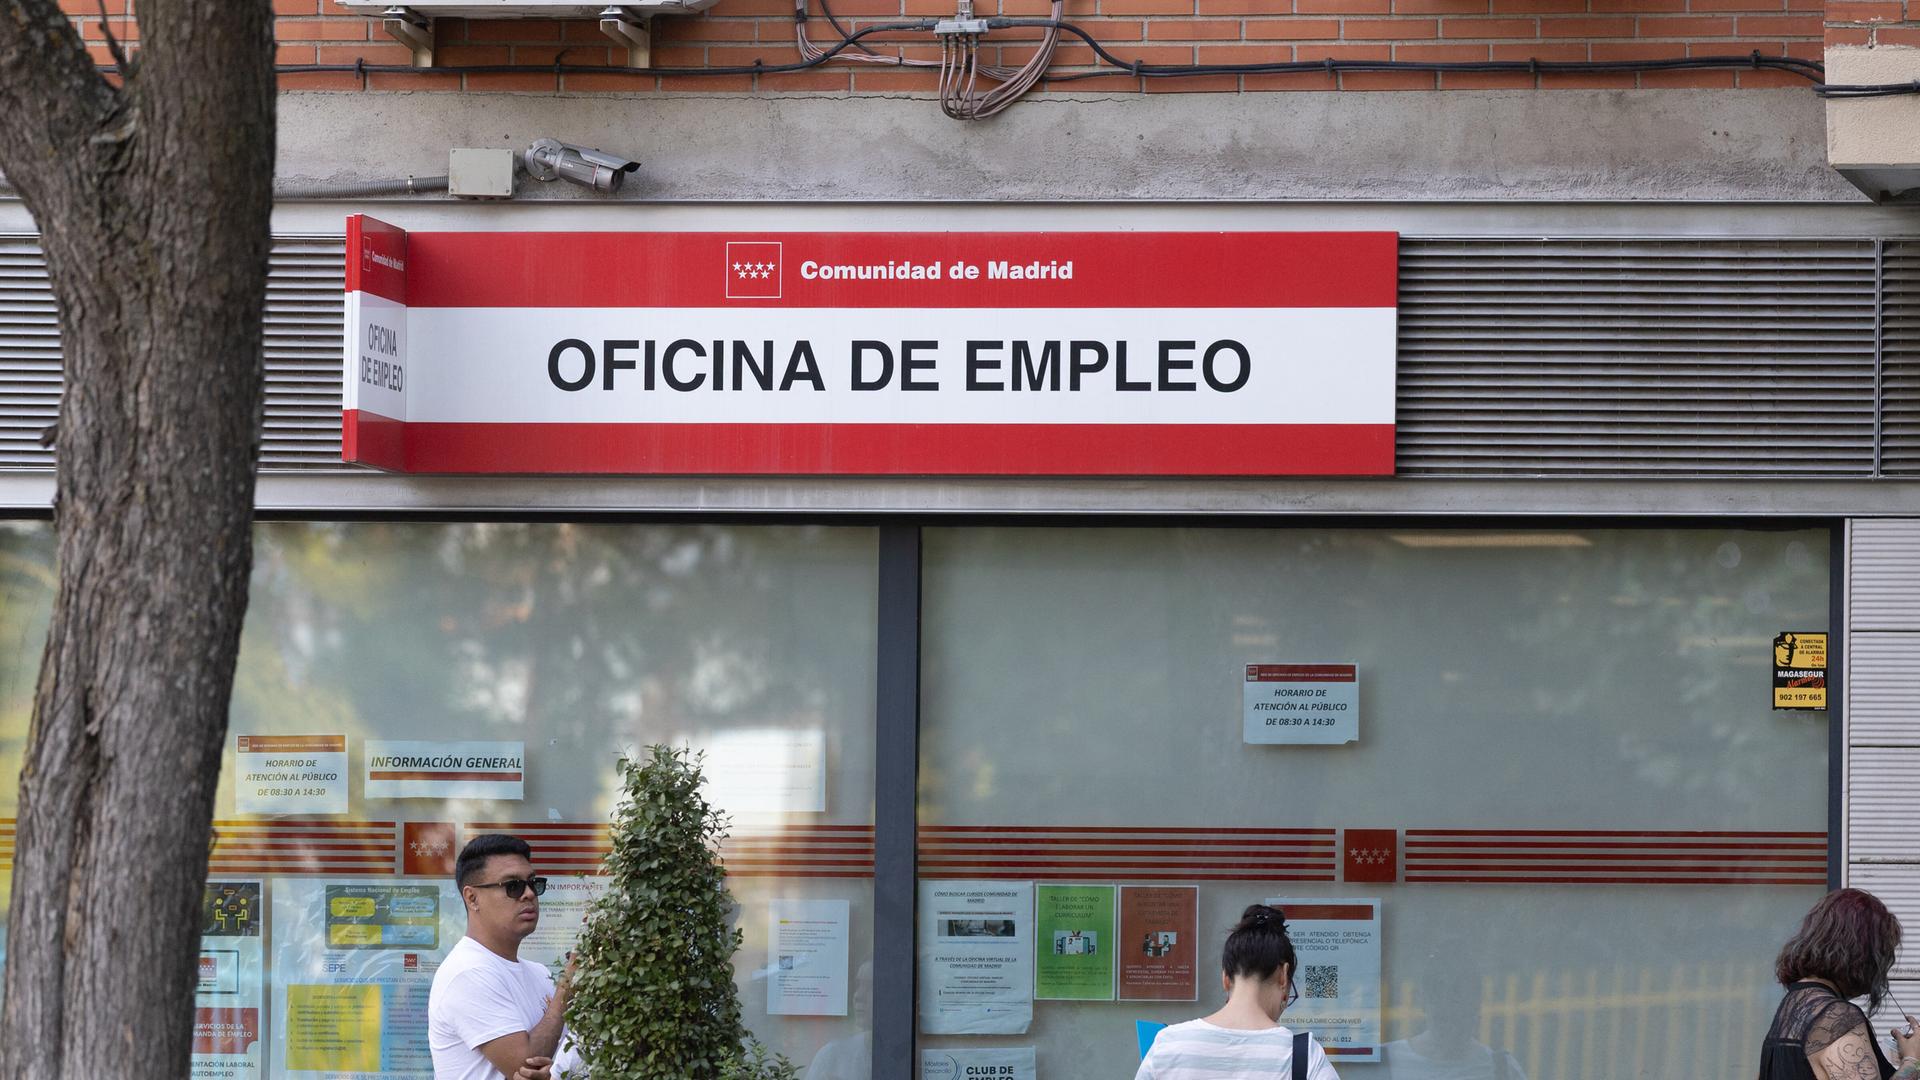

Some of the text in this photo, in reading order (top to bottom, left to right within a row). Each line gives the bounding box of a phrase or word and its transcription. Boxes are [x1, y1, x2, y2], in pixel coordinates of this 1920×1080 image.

[372, 250, 404, 272] Comunidad de Madrid
[800, 260, 1074, 280] Comunidad de Madrid
[368, 323, 397, 357] OFICINA
[547, 338, 1252, 393] OFICINA DE EMPLEO
[361, 355, 403, 393] DE EMPLEO
[1777, 670, 1824, 678] MAGASEGUR
[1274, 689, 1327, 697] HORARIO DE
[1254, 702, 1298, 711] ATENCIÓN
[1311, 702, 1347, 711] PÚBLICO
[1265, 718, 1335, 726] DE 08:30 A 14:30
[265, 759, 317, 768] HORARIO DE
[371, 755, 522, 769] INFORMACIÓN GENERAL
[245, 771, 338, 782] ATENCIÓN AL PÚBLICO
[257, 788, 326, 796] DE 08:30 A 14:30
[322, 964, 346, 972] SEPE
[966, 1066, 1014, 1075] CLUB DE
